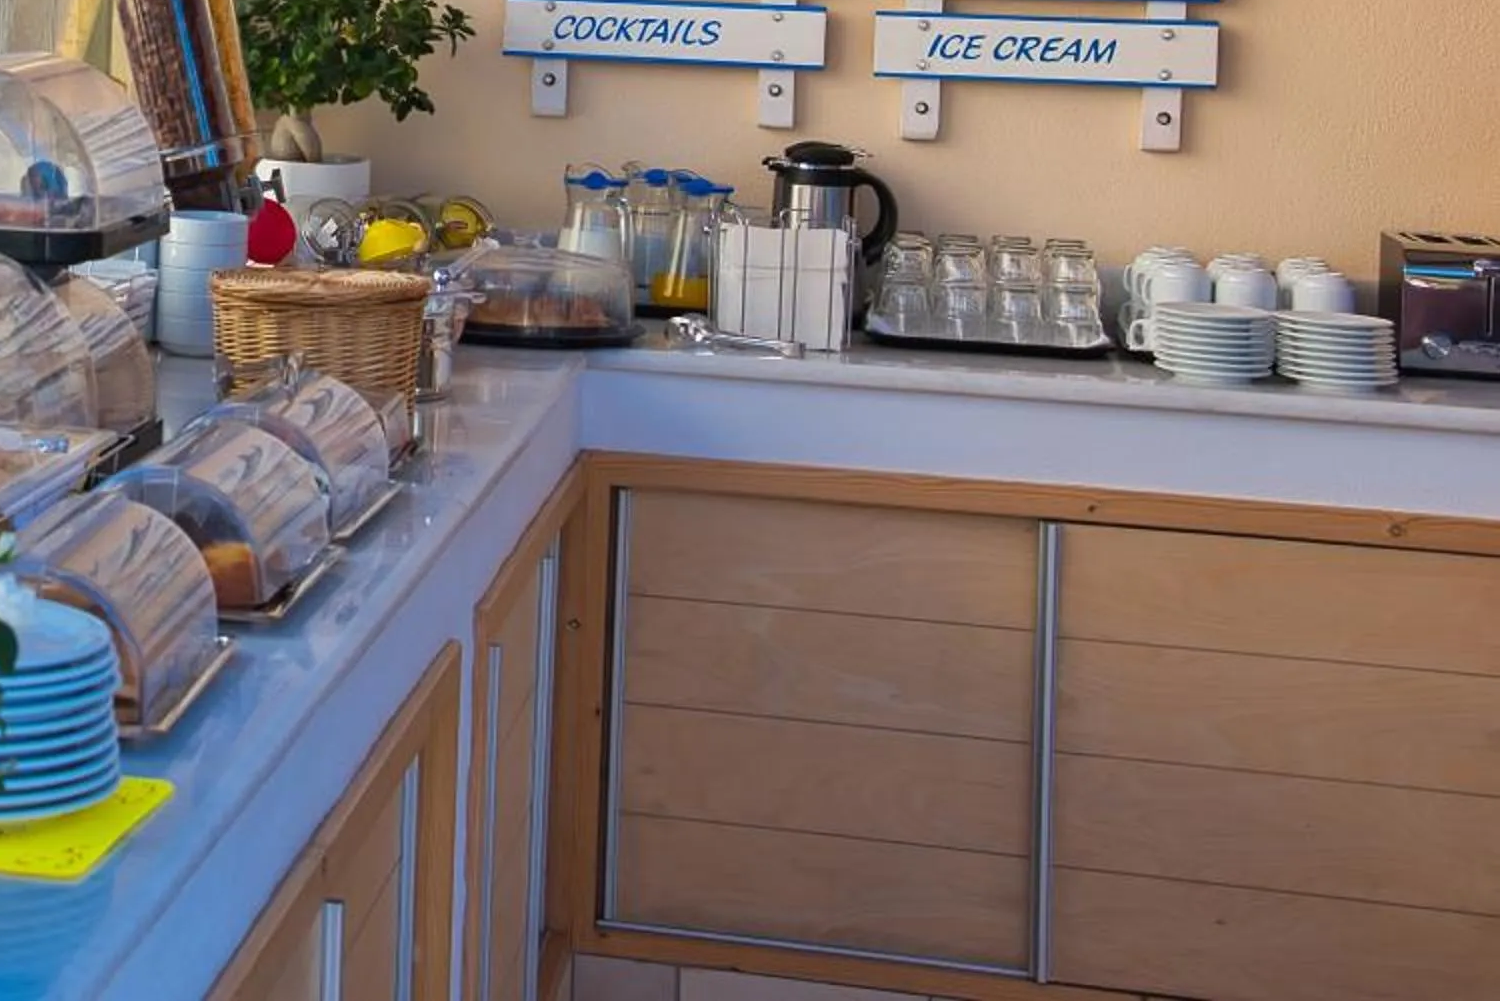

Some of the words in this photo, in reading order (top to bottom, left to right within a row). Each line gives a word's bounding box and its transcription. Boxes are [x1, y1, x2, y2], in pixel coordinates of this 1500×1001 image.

[553, 14, 722, 47] COCKTAILS
[926, 31, 982, 62] ICE
[992, 34, 1119, 63] CREAM
